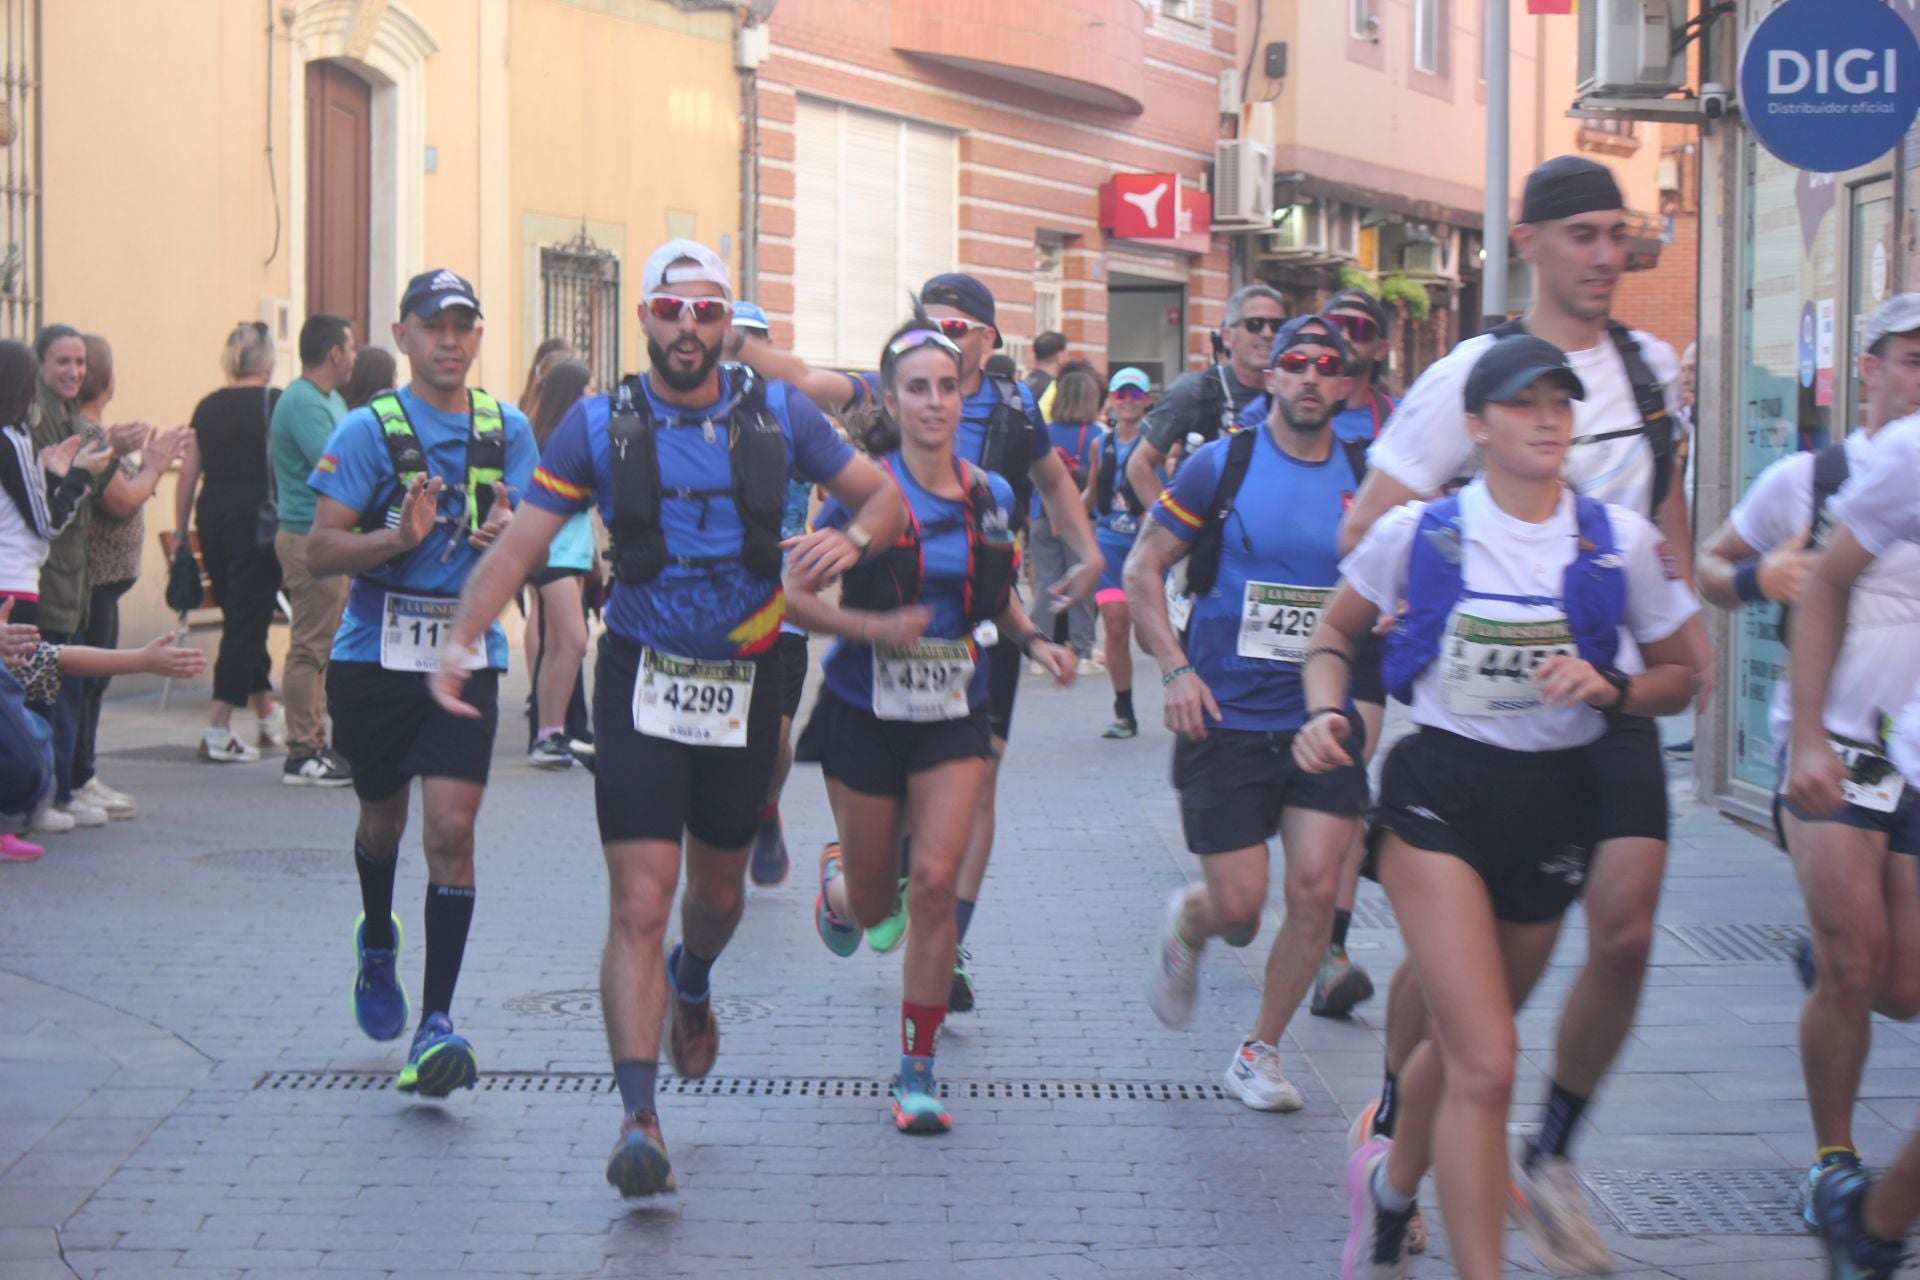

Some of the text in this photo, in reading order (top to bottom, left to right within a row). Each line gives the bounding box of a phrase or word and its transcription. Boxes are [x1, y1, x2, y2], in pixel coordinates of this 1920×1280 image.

[1768, 49, 1897, 94] DIGI
[1768, 102, 1896, 114] Distribuidor oficial
[1268, 608, 1317, 638] 429
[1478, 648, 1567, 683] 445
[664, 682, 735, 714] 4299
